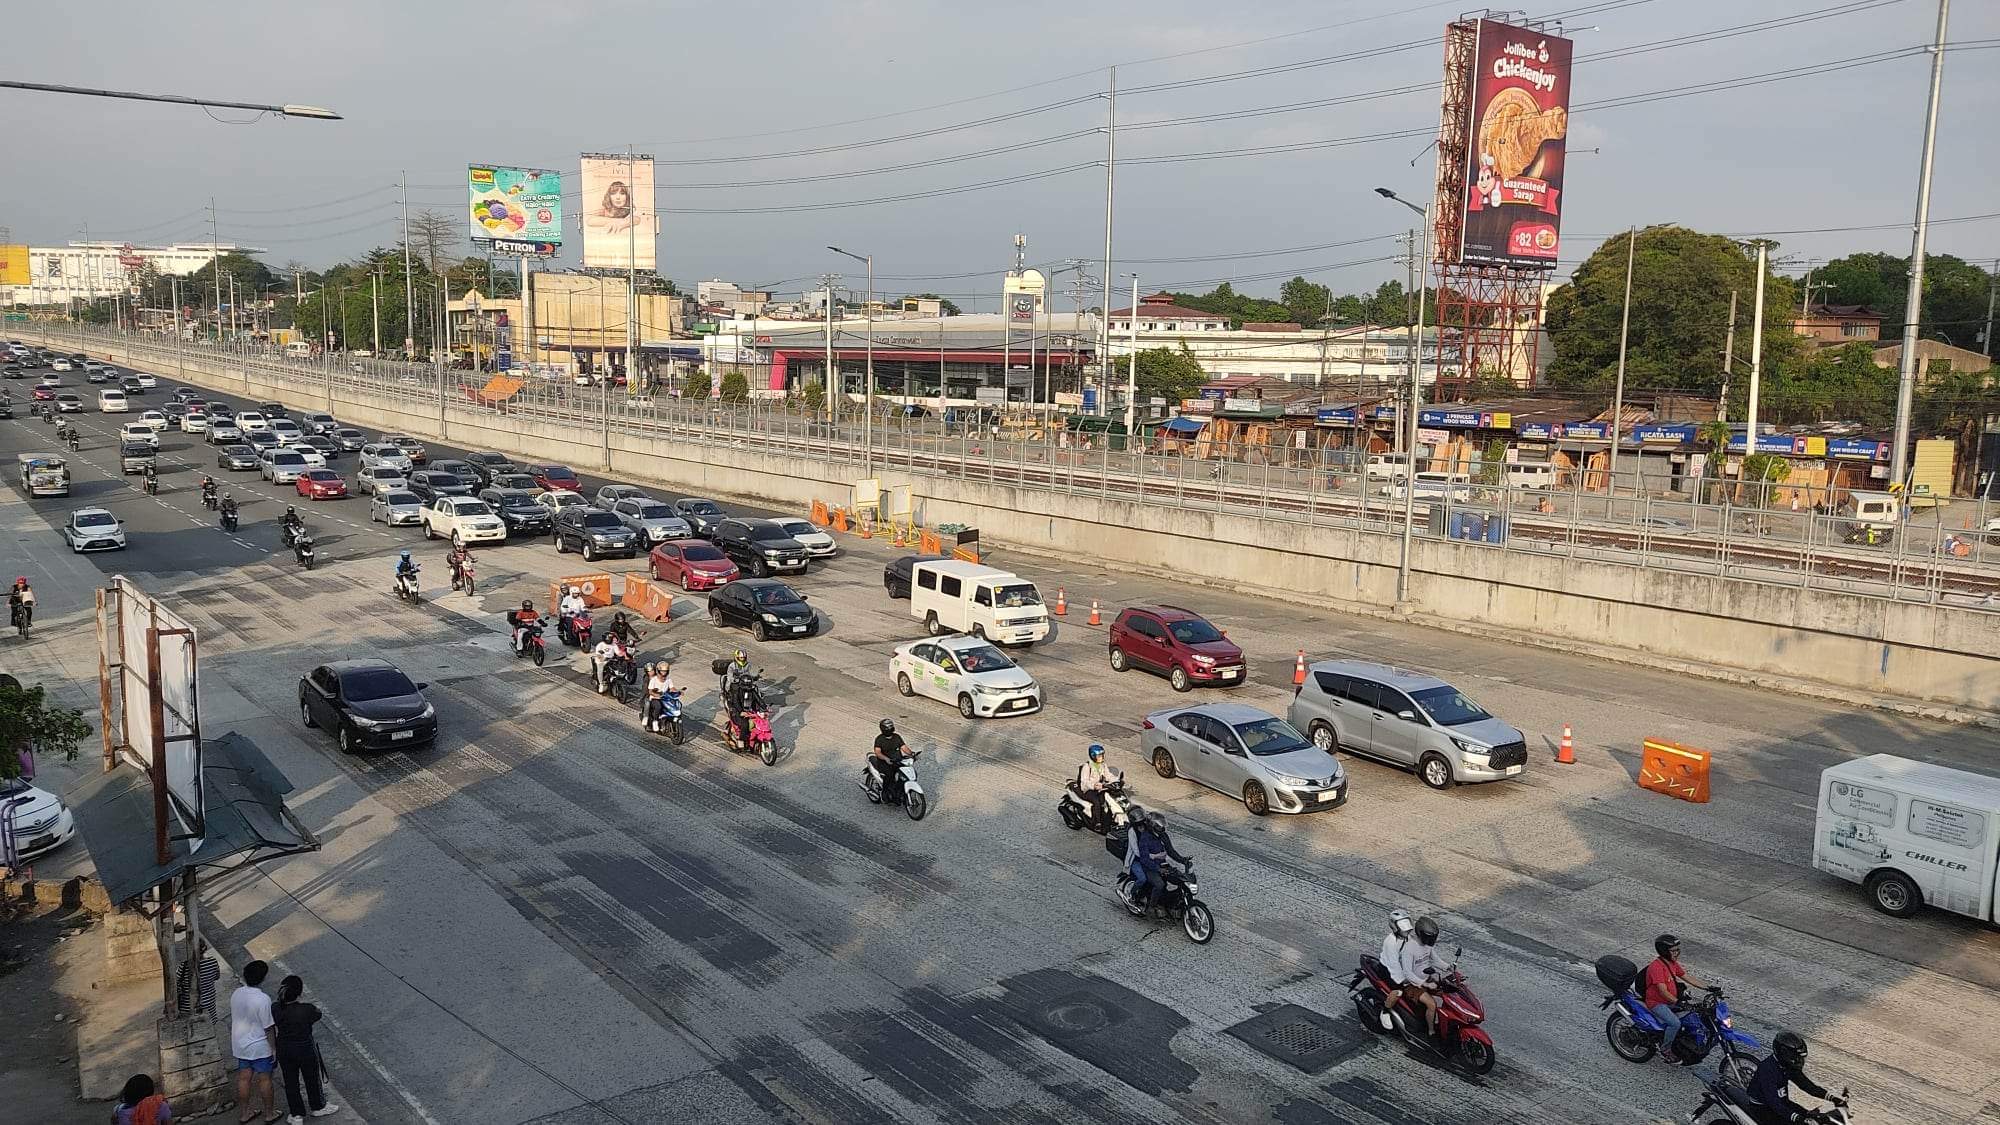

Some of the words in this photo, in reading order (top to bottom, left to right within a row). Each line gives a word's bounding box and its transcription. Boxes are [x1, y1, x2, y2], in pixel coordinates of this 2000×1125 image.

[1503, 41, 1537, 60] Jollibee
[1493, 57, 1557, 92] Chickenjoy
[1503, 178, 1547, 194] Guaranteed
[1513, 189, 1535, 204] Sarap
[1666, 432, 1685, 440] SASH
[1850, 787, 1864, 798] LG
[1905, 850, 1968, 872] CHILLER
